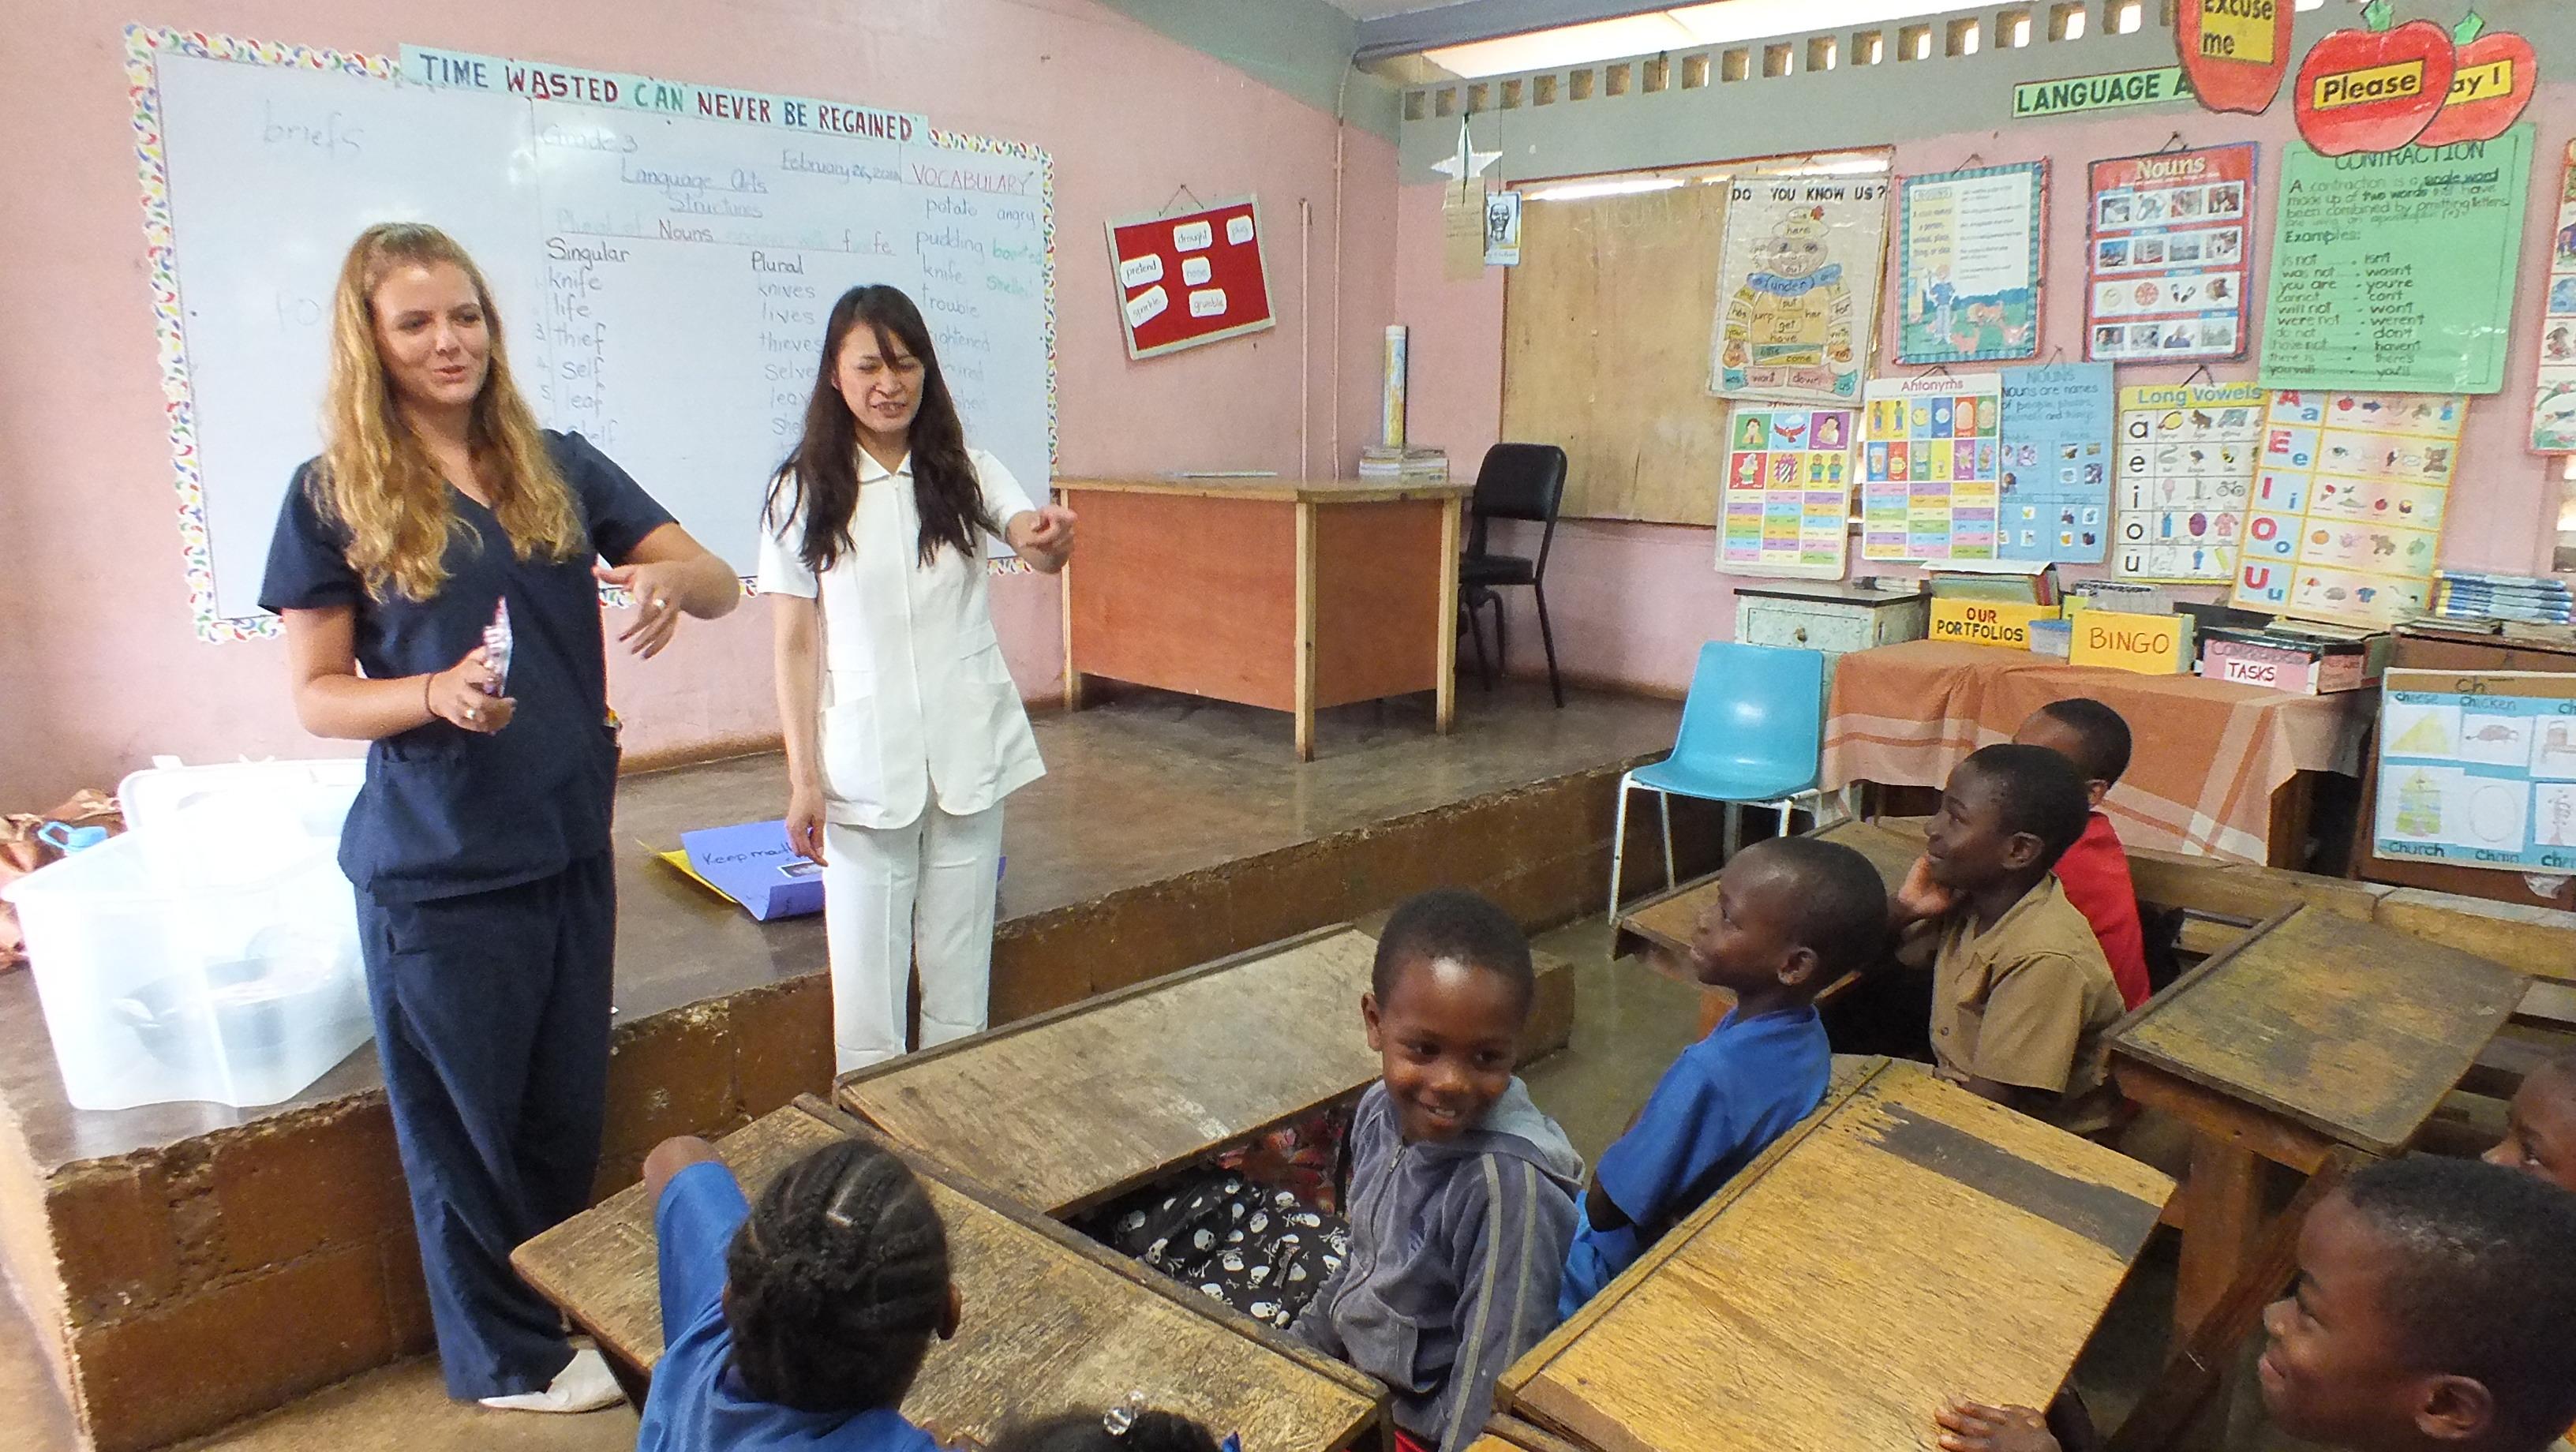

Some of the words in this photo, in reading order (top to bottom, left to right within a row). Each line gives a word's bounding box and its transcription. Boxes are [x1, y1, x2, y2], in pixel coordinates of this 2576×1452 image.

[2203, 32, 2235, 55] me
[419, 53, 489, 88] TIME
[505, 65, 618, 103] WASTED
[634, 80, 683, 112] CAN
[698, 91, 771, 123] NEVER
[784, 101, 807, 126] BE
[818, 104, 913, 142] REGAINED
[2017, 73, 2160, 113] LANGUAGE
[2323, 74, 2417, 103] Please
[2451, 75, 2484, 95] ay
[263, 99, 364, 159] briefs
[2335, 140, 2485, 170] CONTRACTION
[620, 156, 713, 197] Language
[912, 163, 1031, 196] VOCABULARY
[2136, 157, 2206, 180] Nouns
[1732, 188, 1751, 201] DO
[1769, 187, 1795, 201] YOU
[1807, 187, 1844, 201] KNOW
[2290, 179, 2303, 193] A
[2362, 191, 2386, 201] two
[2390, 184, 2428, 199] words
[927, 196, 978, 220] potato
[997, 208, 1035, 230] angry
[658, 219, 714, 241] Nouns
[545, 238, 631, 271] Singular
[916, 225, 985, 265] pudding
[751, 249, 804, 275] Plural
[1126, 260, 1156, 280] pretend
[548, 265, 603, 298] knife
[758, 274, 816, 298] knives
[1771, 280, 1807, 292] under
[2279, 281, 2305, 294] you
[2310, 280, 2337, 290] are
[553, 293, 591, 322] life
[762, 299, 816, 325] lives
[922, 283, 978, 316] trouble
[554, 321, 606, 354] thief
[1770, 334, 1798, 342] have
[1779, 320, 1795, 332] get
[1901, 379, 1964, 392] Antonyms
[2039, 387, 2060, 396] are
[2064, 385, 2099, 395] names
[2138, 389, 2187, 406] Long
[2193, 386, 2263, 402] Vowels
[565, 380, 606, 418] leaf
[2278, 389, 2301, 406] A
[2301, 406, 2320, 421] a
[2046, 410, 2063, 420] and
[2268, 430, 2292, 455] E
[2293, 452, 2308, 466] e
[2288, 492, 2297, 509] i
[2251, 518, 2277, 541] O
[2274, 541, 2291, 554] o
[2245, 566, 2270, 590] U
[2267, 588, 2283, 601] u
[1966, 607, 1998, 624] OUR
[1936, 619, 2024, 642] PORTFOLIOS
[2089, 627, 2170, 655] BINGO
[2228, 662, 2275, 682] TASKS
[702, 853, 748, 866] Keep
